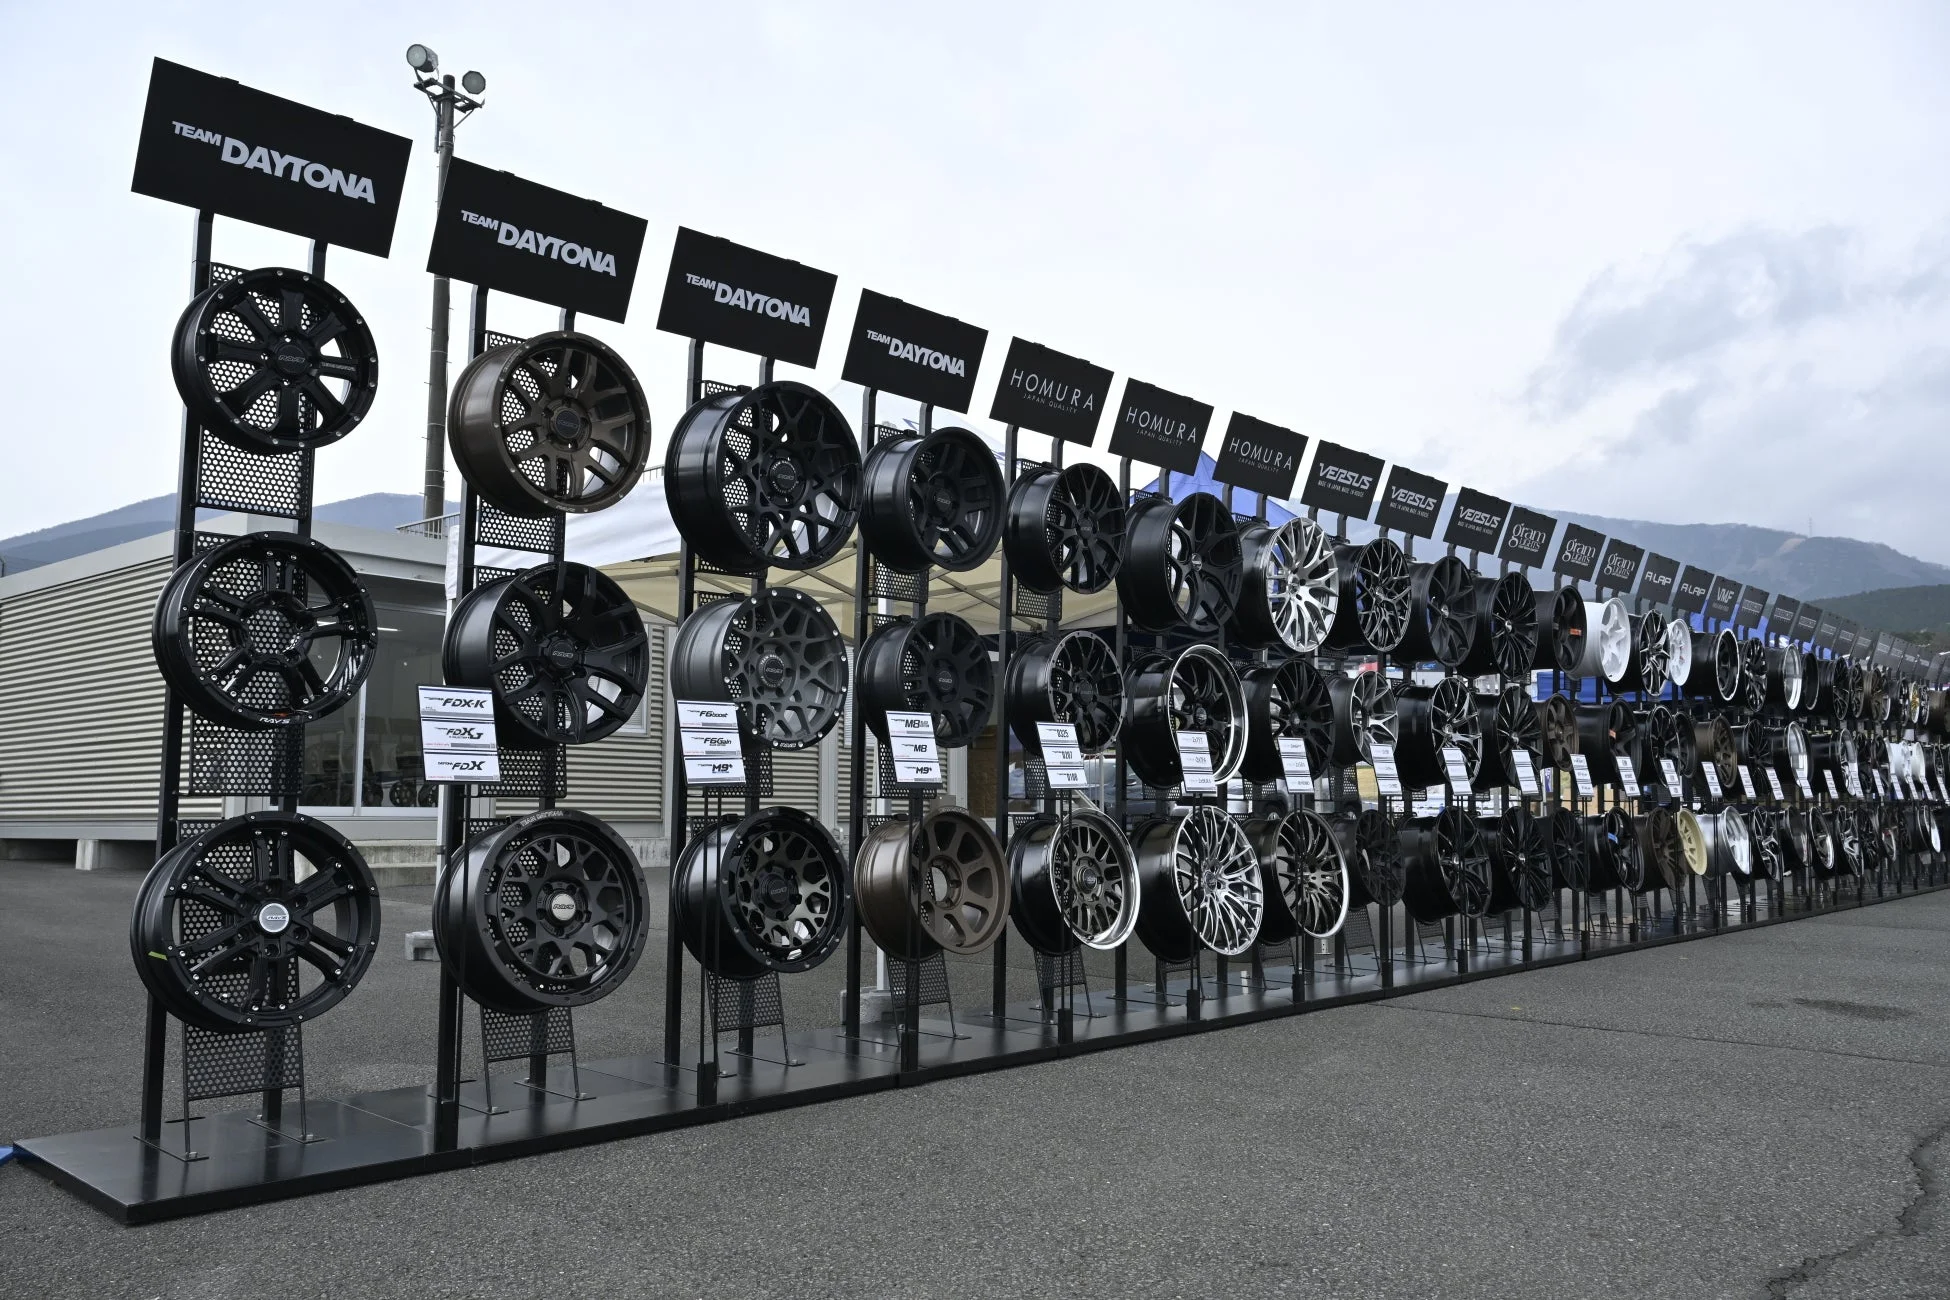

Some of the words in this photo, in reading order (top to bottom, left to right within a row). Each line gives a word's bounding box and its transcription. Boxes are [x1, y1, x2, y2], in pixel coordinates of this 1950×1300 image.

[172, 121, 222, 146] TEAM
[221, 136, 376, 204] DAYTONA
[461, 210, 499, 231] TEAM
[497, 222, 617, 277] DAYTONA
[686, 273, 716, 291] TEAM
[714, 282, 811, 327] DAYTONA
[867, 330, 891, 345] TEAM
[888, 338, 965, 377] DAYTONA
[1010, 368, 1093, 411] HOMURA
[1023, 393, 1045, 404] JAPAN
[1049, 401, 1077, 414] QUALITY
[1126, 406, 1196, 443] HOMURA
[1229, 437, 1292, 471] HOMURA
[1319, 462, 1374, 490] VERSUS
[1391, 485, 1438, 511] VERSUS
[1460, 505, 1502, 529] VERSUS
[1508, 523, 1546, 548] gram
[1562, 538, 1596, 562] gram
[1604, 553, 1635, 575] gram
[442, 697, 487, 709] FDX-K
[904, 719, 920, 728] M8
[913, 744, 928, 752] M8
[452, 760, 486, 771] FDX
